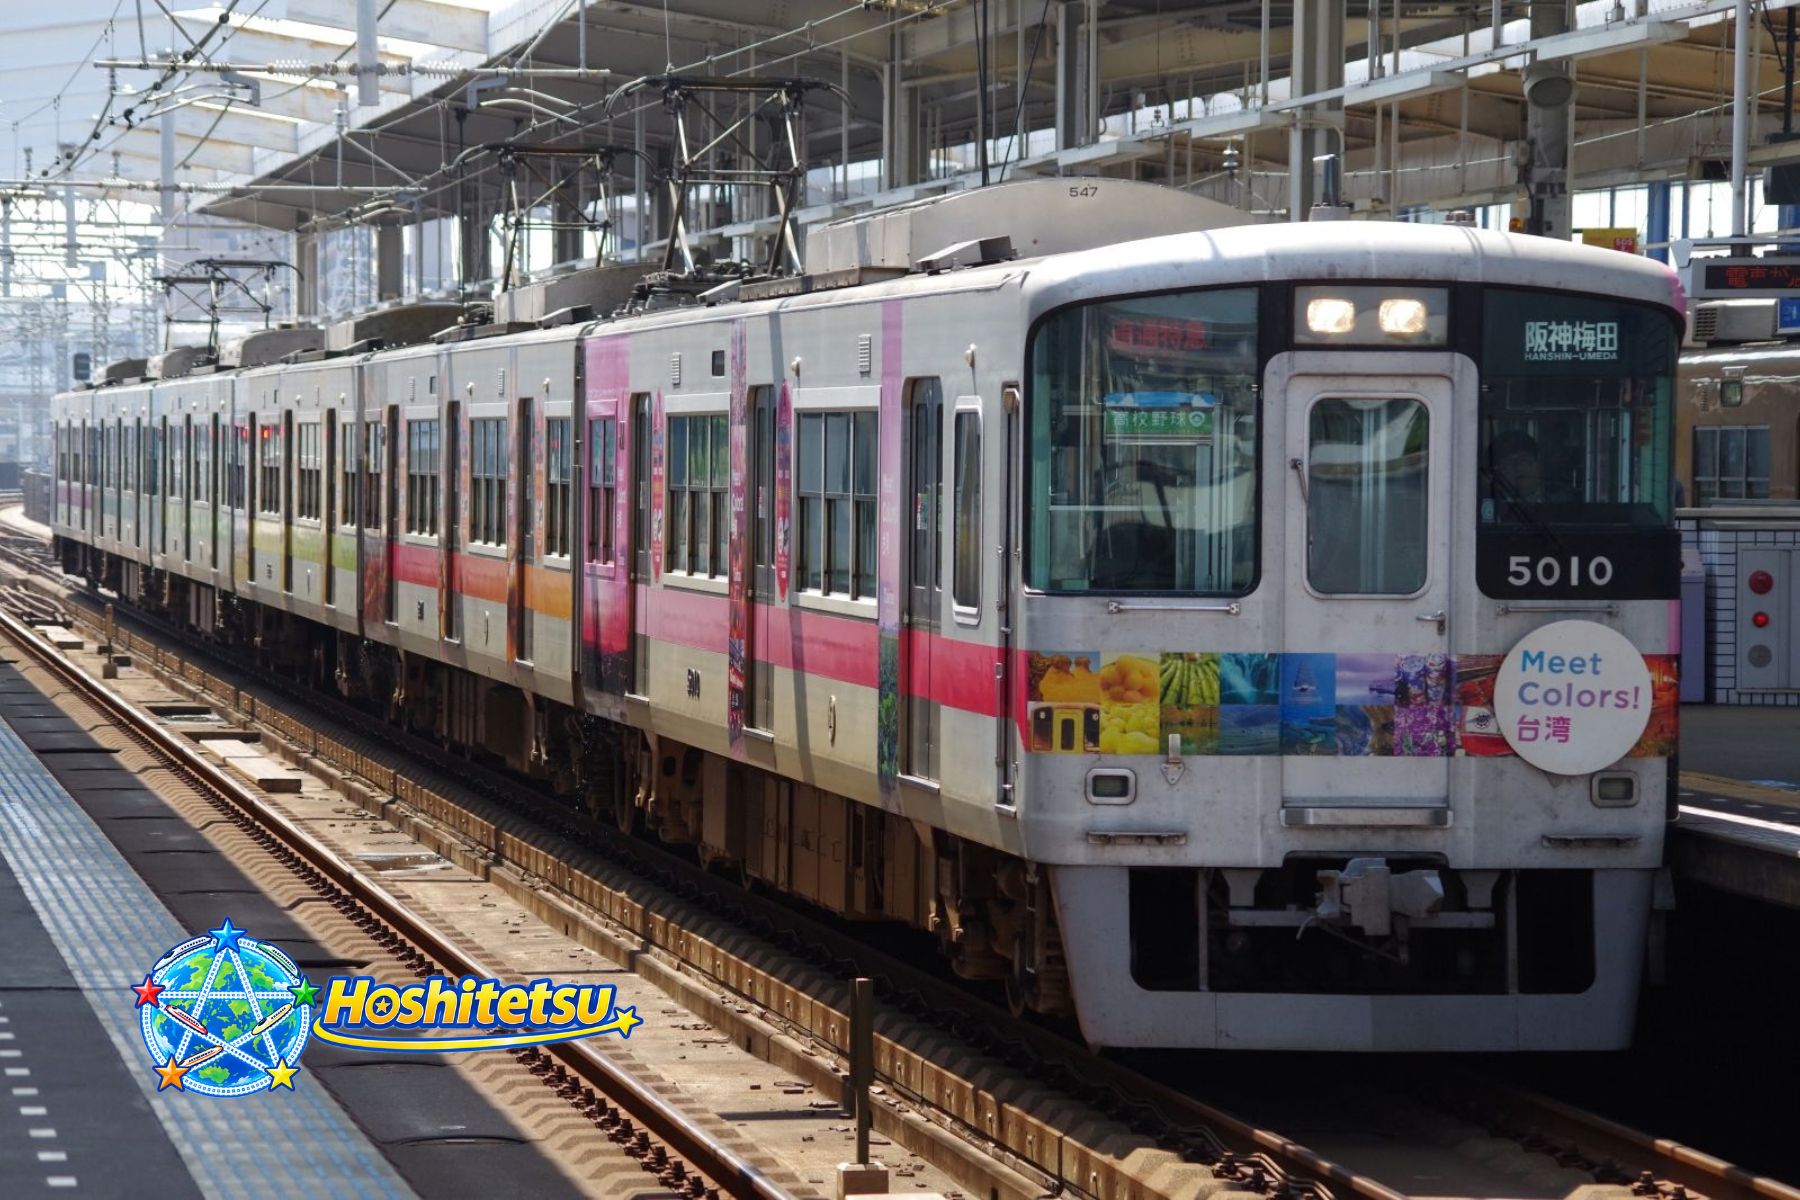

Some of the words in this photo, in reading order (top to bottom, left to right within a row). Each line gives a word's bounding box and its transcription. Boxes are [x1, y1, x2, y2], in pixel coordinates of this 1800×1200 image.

[1069, 186, 1098, 197] 547
[1525, 320, 1618, 352] 阪神梅田
[1524, 352, 1618, 361] HANSHIN-UMEDA
[1112, 411, 1187, 427] 高校野球
[1507, 555, 1613, 587] 5010
[1521, 649, 1603, 675] Meet
[1518, 681, 1641, 709] Colors!
[1517, 714, 1572, 744] 台湾
